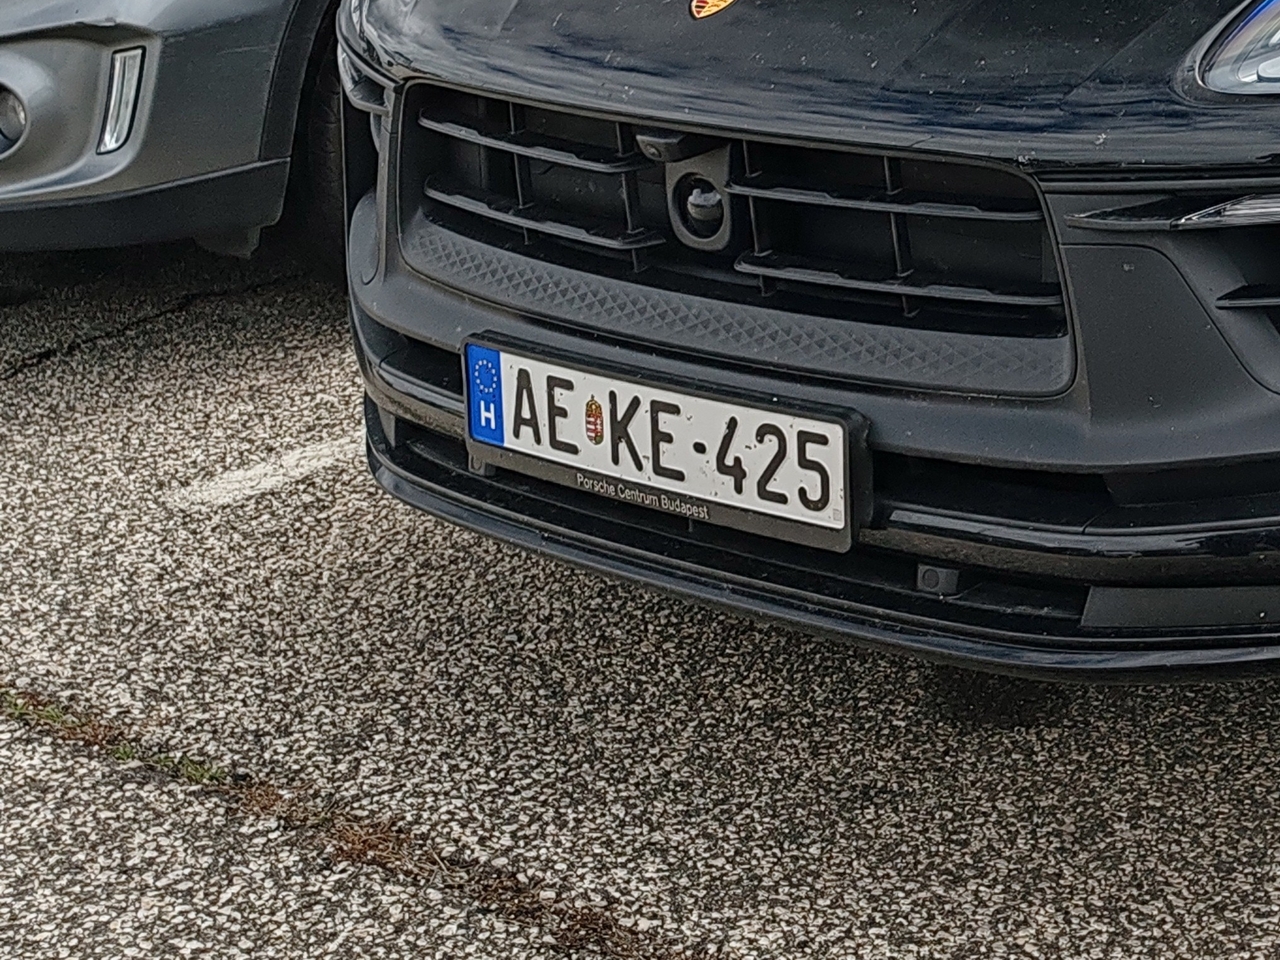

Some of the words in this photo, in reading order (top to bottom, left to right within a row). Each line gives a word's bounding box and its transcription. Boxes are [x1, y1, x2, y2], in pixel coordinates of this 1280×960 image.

[480, 400, 496, 430] H
[512, 367, 580, 455] AE
[607, 389, 831, 512] KE-425
[576, 473, 616, 496] Porsche
[618, 484, 659, 507] Centrum
[660, 494, 709, 519] Budapest
